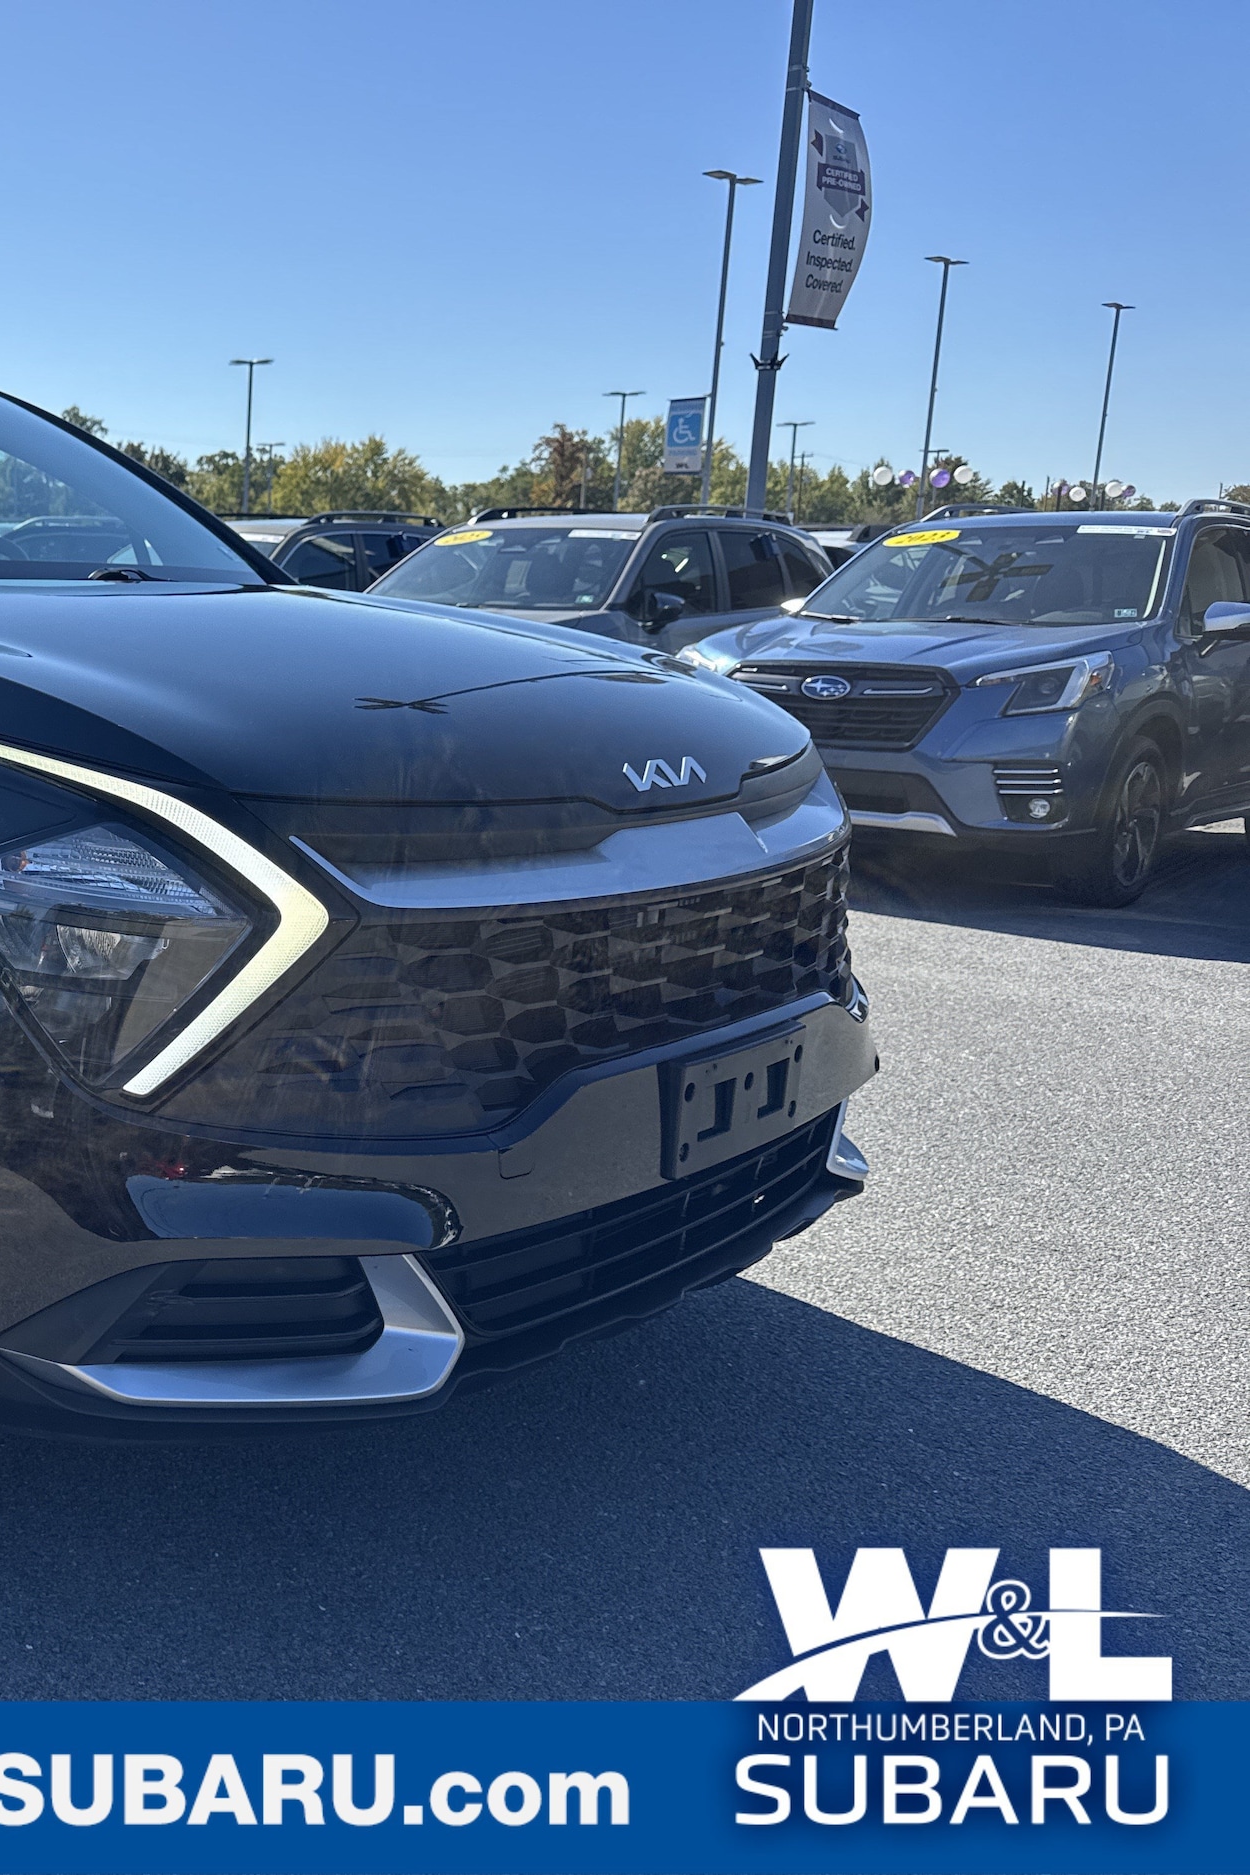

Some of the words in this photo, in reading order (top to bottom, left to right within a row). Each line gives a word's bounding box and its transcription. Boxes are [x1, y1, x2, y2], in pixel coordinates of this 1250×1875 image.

[822, 176, 862, 191] PRE-OWNED
[825, 168, 859, 182] CERTIFIED
[813, 229, 856, 250] Certified.
[806, 251, 854, 272] Inspected.
[805, 273, 844, 293] Covered.
[622, 756, 707, 792] KIA
